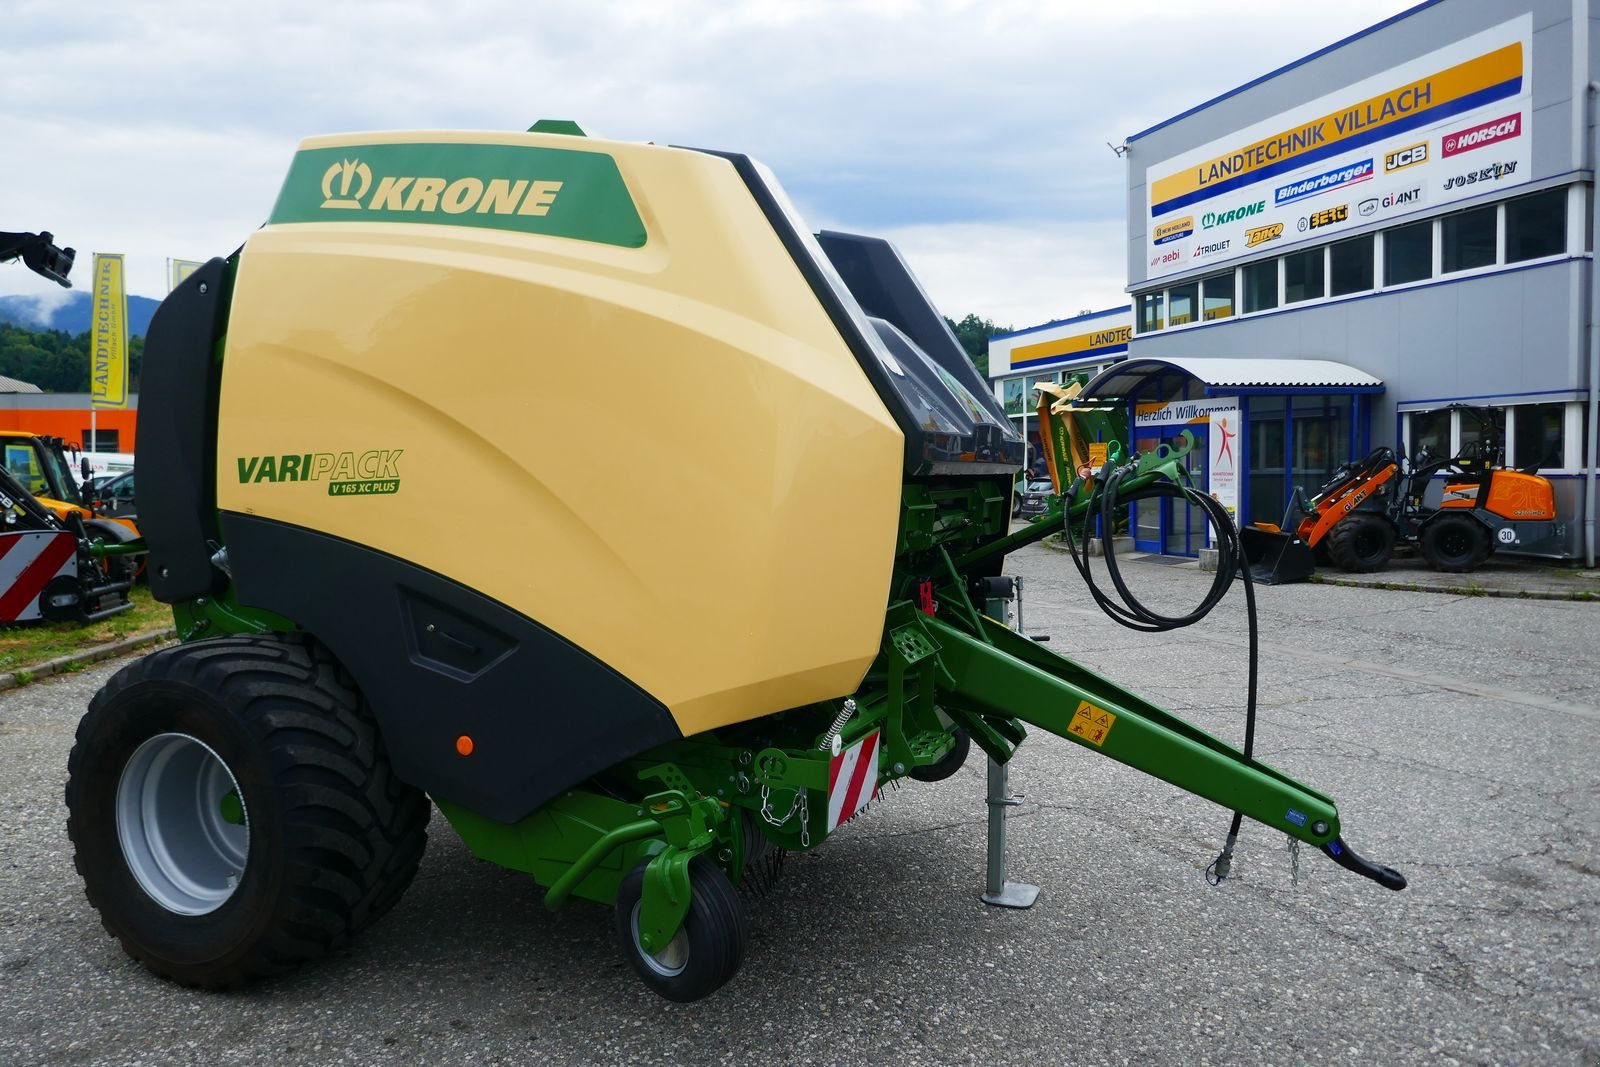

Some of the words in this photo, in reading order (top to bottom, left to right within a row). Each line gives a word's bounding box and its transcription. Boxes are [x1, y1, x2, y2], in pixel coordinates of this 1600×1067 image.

[1199, 122, 1325, 185] LANDTECHNIK
[1334, 82, 1432, 135] VILLACH
[1457, 119, 1517, 149] HORSCH
[1387, 144, 1426, 171] JCB
[1277, 162, 1371, 200] Binderberger
[1443, 160, 1518, 190] JOSKIN
[368, 177, 563, 217] KRONE
[1172, 221, 1191, 232] HOLLAND
[1216, 200, 1266, 226] KRONE
[1162, 249, 1180, 263] aebi
[1200, 239, 1231, 255] TRIOLIET
[93, 262, 112, 397] LANDTECHNIK
[1137, 407, 1172, 422] Herzlich
[237, 449, 404, 484] VARIPACK
[333, 485, 339, 494] V
[341, 484, 357, 493] 165
[358, 483, 371, 493] XC
[373, 482, 396, 492] PLUS
[1501, 531, 1512, 540] 30
